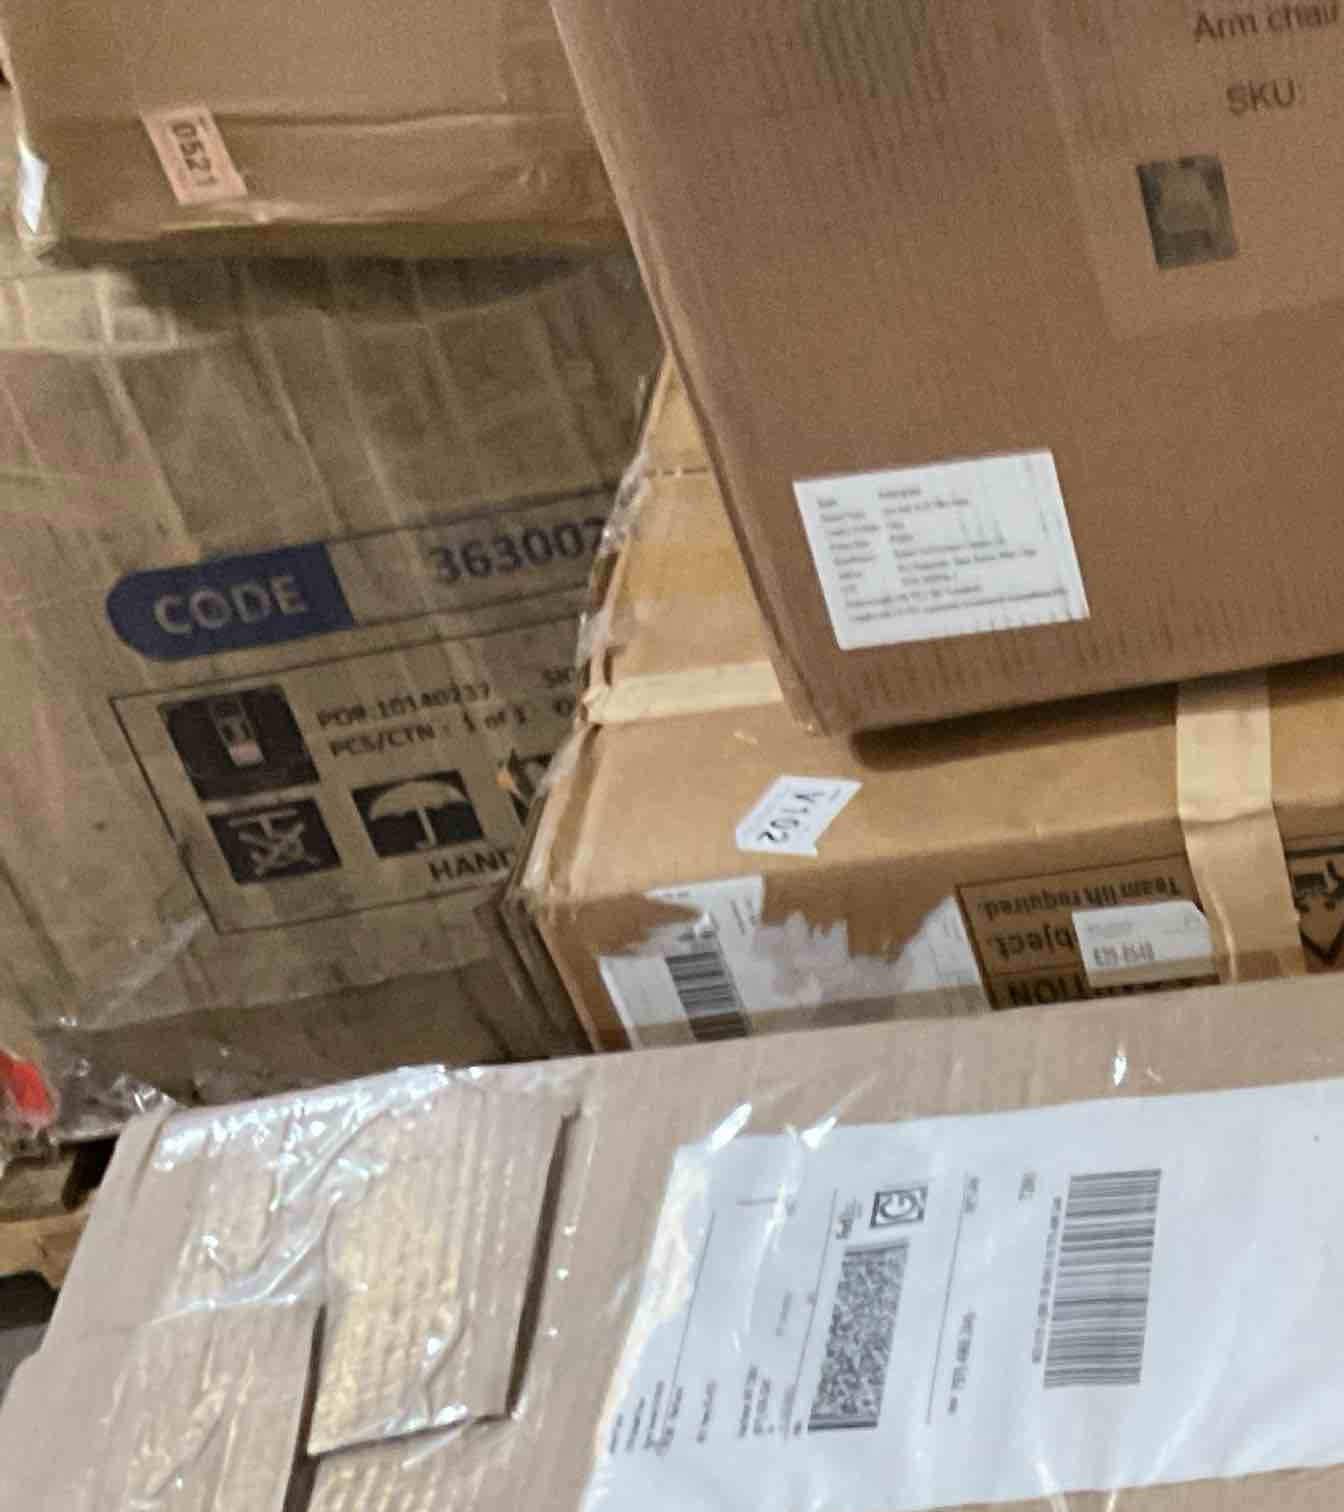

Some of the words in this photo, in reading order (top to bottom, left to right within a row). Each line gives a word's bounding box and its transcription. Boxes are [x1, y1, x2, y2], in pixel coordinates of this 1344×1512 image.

[1193, 8, 1258, 43] Arm
[153, 575, 306, 637] CODE
[1121, 875, 1182, 898] Team
